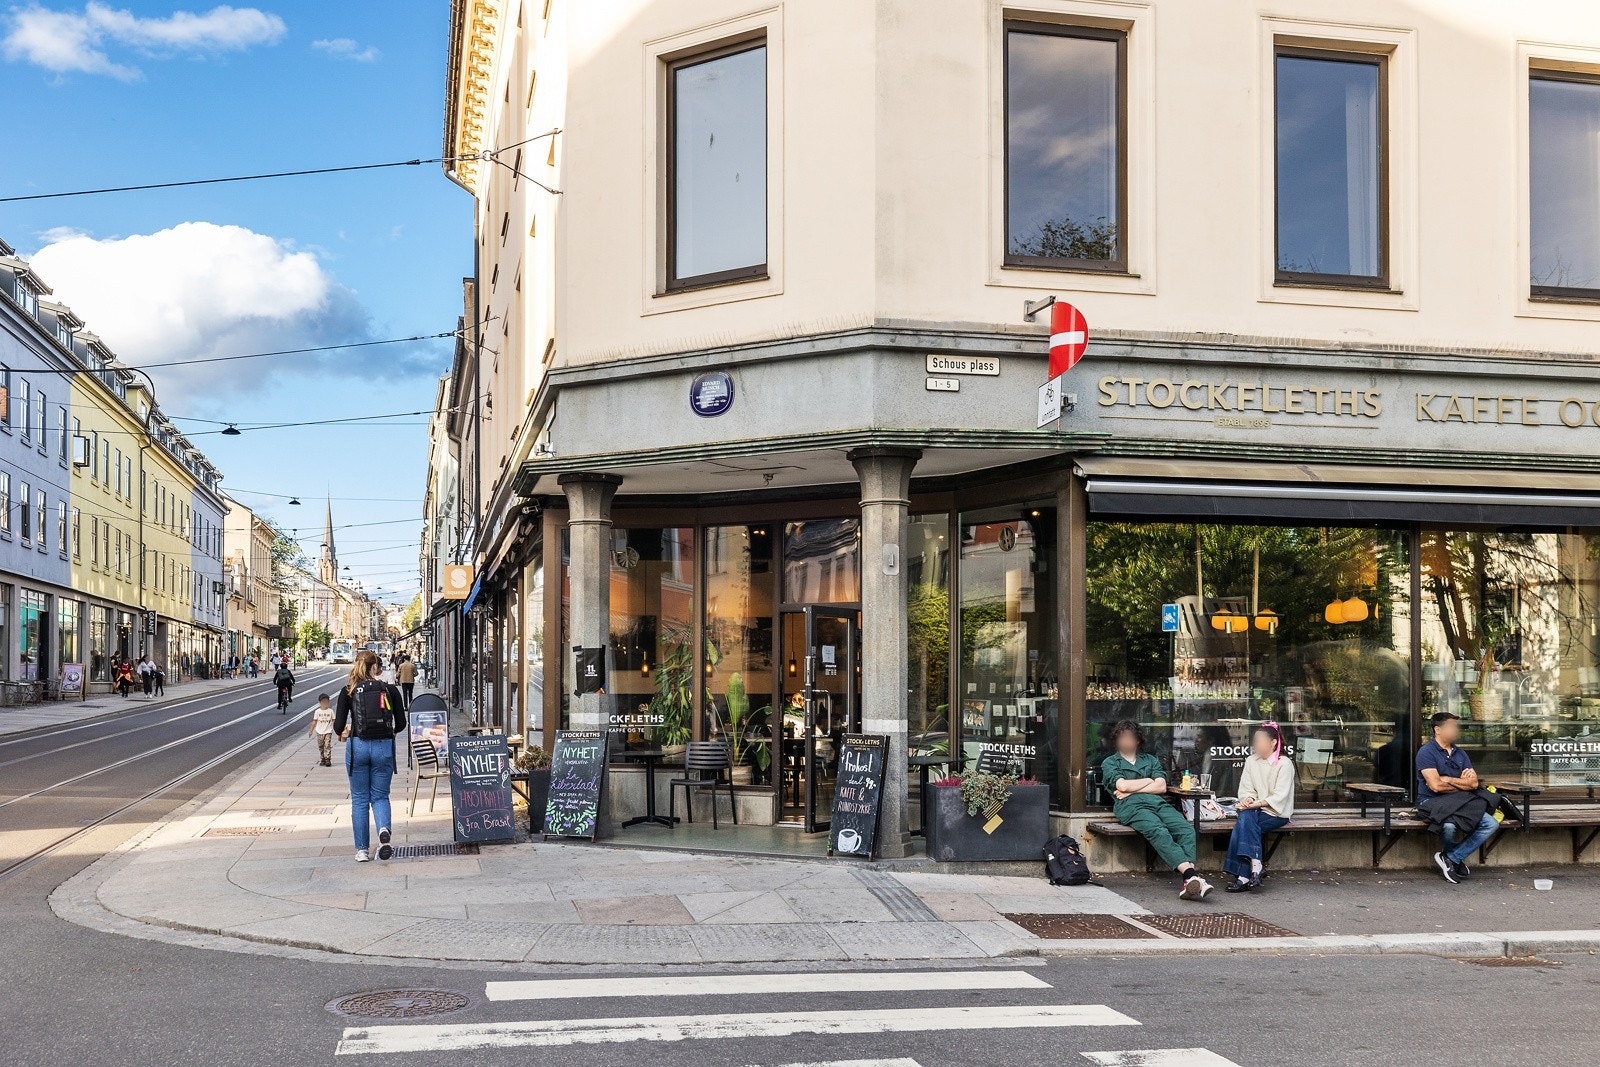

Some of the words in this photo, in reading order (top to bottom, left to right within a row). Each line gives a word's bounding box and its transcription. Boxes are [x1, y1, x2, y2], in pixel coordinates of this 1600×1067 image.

[932, 357, 966, 370] Schous
[970, 359, 994, 371] plass
[1098, 376, 1382, 417] STOCKFLETHS
[1416, 392, 1541, 426] KAFFE
[609, 714, 665, 723] CKFLETHS
[456, 739, 501, 748] STOCKFLETHS
[979, 742, 1036, 756] STOCKFLETHS
[1210, 745, 1294, 756] STOCKS
[1531, 743, 1600, 753] STOCKFLETH
[562, 746, 598, 760] NYHET
[460, 753, 507, 776] NYHET
